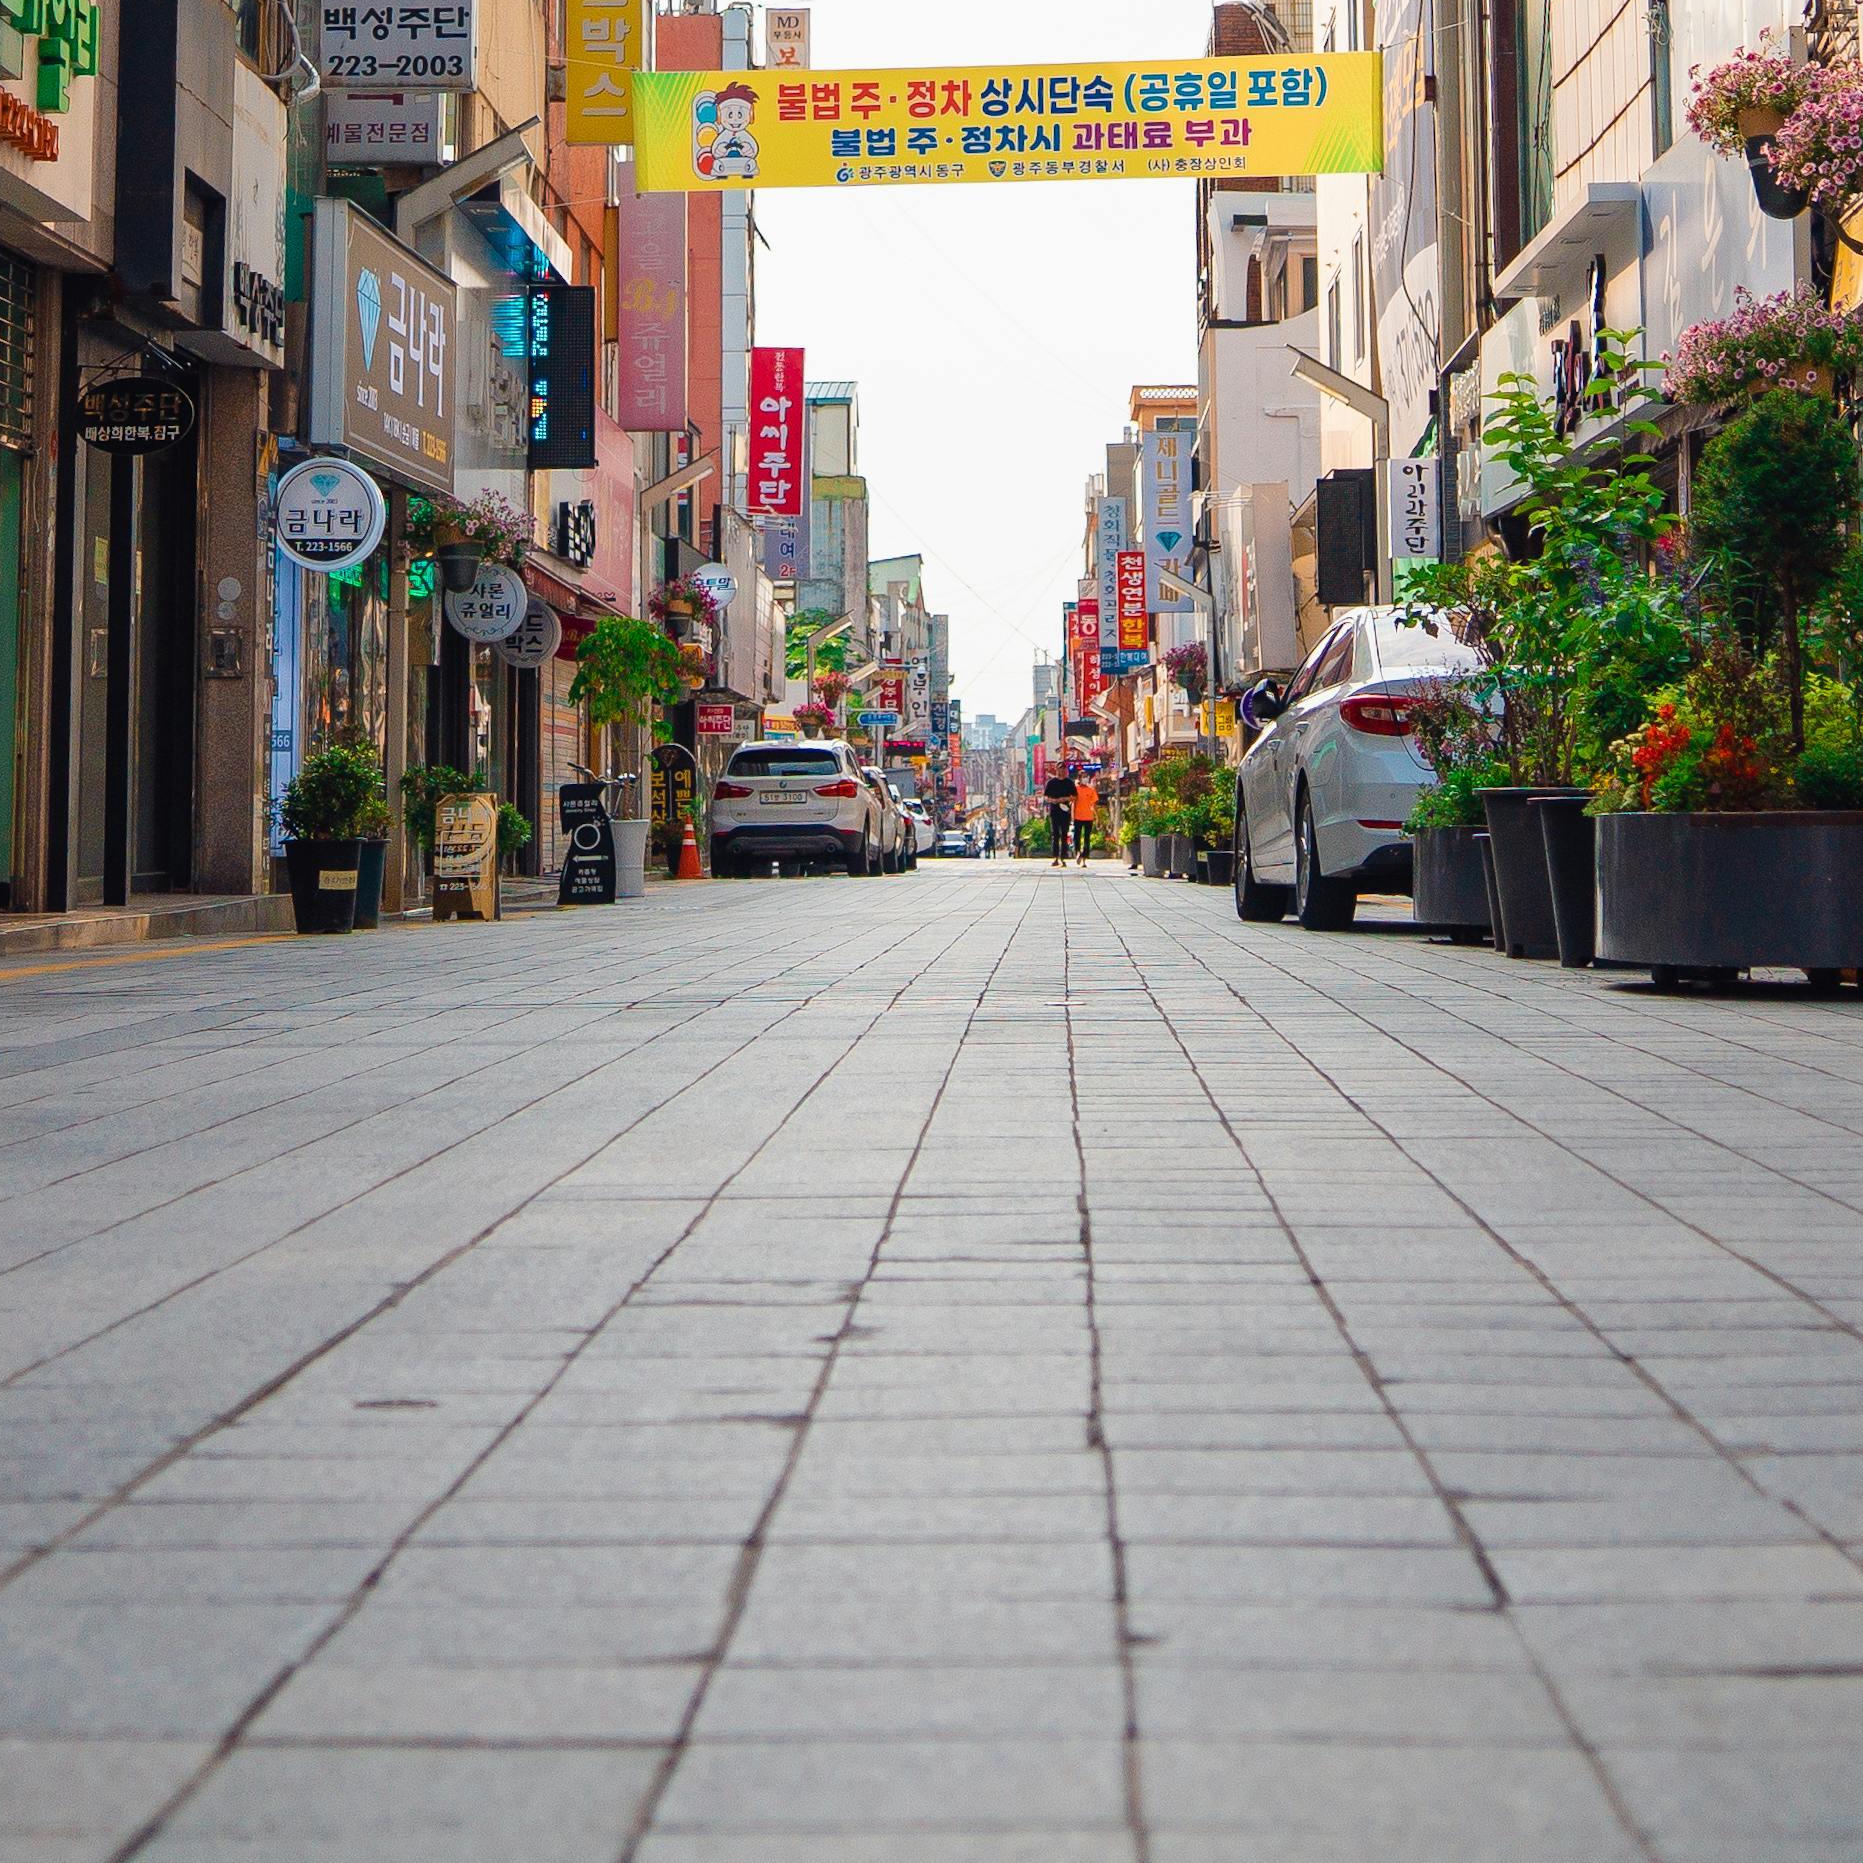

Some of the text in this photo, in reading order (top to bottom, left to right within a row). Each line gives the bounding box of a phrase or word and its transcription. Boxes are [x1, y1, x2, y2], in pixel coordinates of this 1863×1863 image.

[324, 6, 471, 41] 백성주단
[777, 15, 800, 28] MD
[327, 54, 464, 78] 223-2003
[777, 82, 841, 121] 불법
[979, 74, 1115, 117] 상시단속
[1123, 70, 1238, 113] (공휴일
[1246, 65, 1328, 108] 포함)
[831, 127, 896, 158] 불법
[1072, 121, 1174, 152] 과태료
[1184, 118, 1253, 148] 부과
[858, 162, 932, 180] 광주광역시
[935, 162, 965, 178] 동구
[1012, 158, 1126, 176] 광주동부경찰서
[1174, 156, 1247, 172] 충장상인회
[386, 270, 447, 419] 금나라
[758, 395, 793, 506] 아씨주단
[285, 507, 364, 535] 금나라
[305, 539, 354, 553] 223-1566
[460, 603, 511, 620] 쥬얼리
[505, 637, 544, 654] 박스
